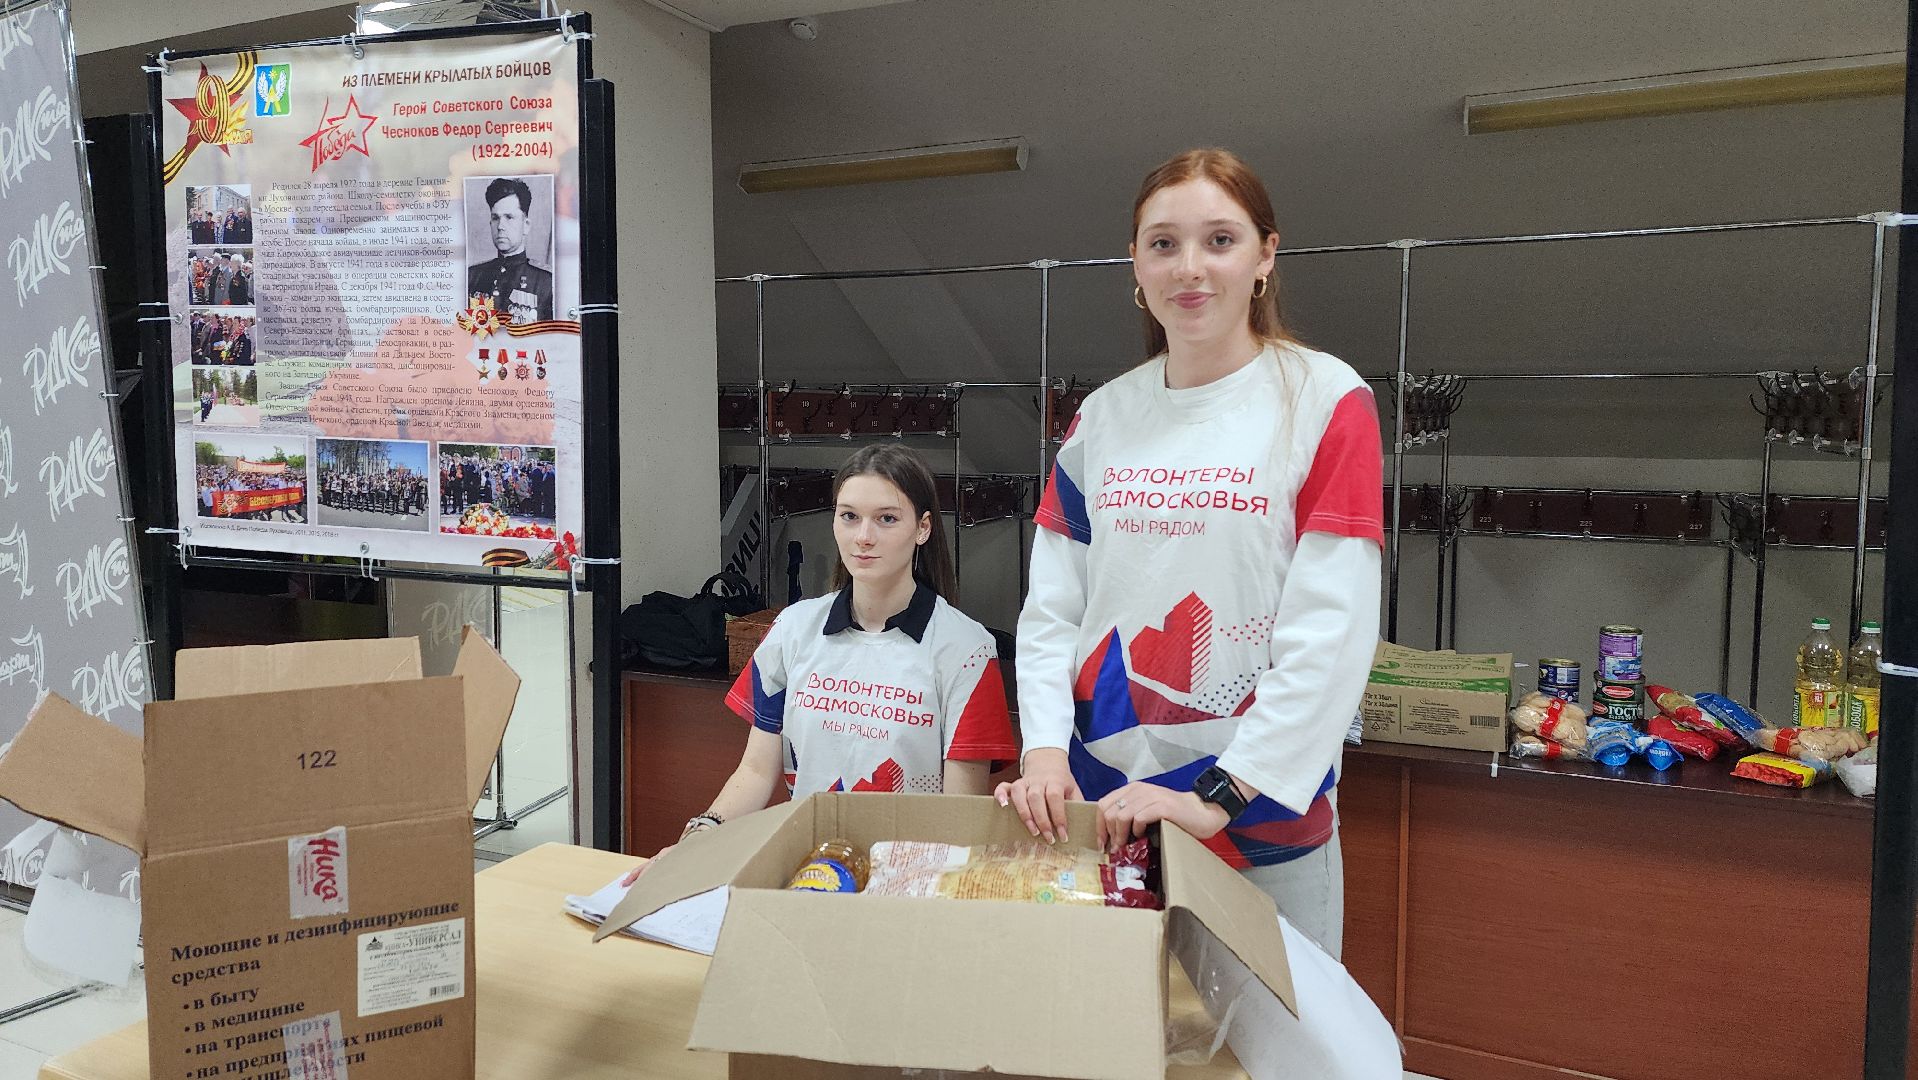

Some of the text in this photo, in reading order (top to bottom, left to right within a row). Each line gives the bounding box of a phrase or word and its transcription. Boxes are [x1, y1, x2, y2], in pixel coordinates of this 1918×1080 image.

[342, 60, 552, 88] ИЗ ПЛЕМЕНИ КРЫЛАТЫХ БОЙЦОВ
[393, 95, 552, 117] Герой Советского Союза
[381, 120, 553, 140] Чесноков Федор Сергеевич
[472, 141, 553, 159] (1922-2004)
[1102, 466, 1255, 487] ВОЛОНТЕРЫ
[1114, 518, 1206, 538] МЫ РЯДОМ
[807, 672, 923, 705] ВОЛОНТЕРЫ
[794, 691, 935, 728] ПОДМОСКОВЬЯ
[821, 719, 889, 741] МЫ РЯДОМ
[296, 749, 338, 770] 122
[307, 838, 340, 903] Ника
[170, 933, 263, 963] Моющие
[267, 932, 280, 946] и
[283, 901, 460, 943] дезинфицирующие
[170, 958, 262, 986] средства
[193, 986, 261, 1011] в быту
[193, 1001, 307, 1034] в медицине
[194, 1040, 218, 1055] на
[197, 1063, 220, 1080] на
[365, 1015, 445, 1044] пищевой
